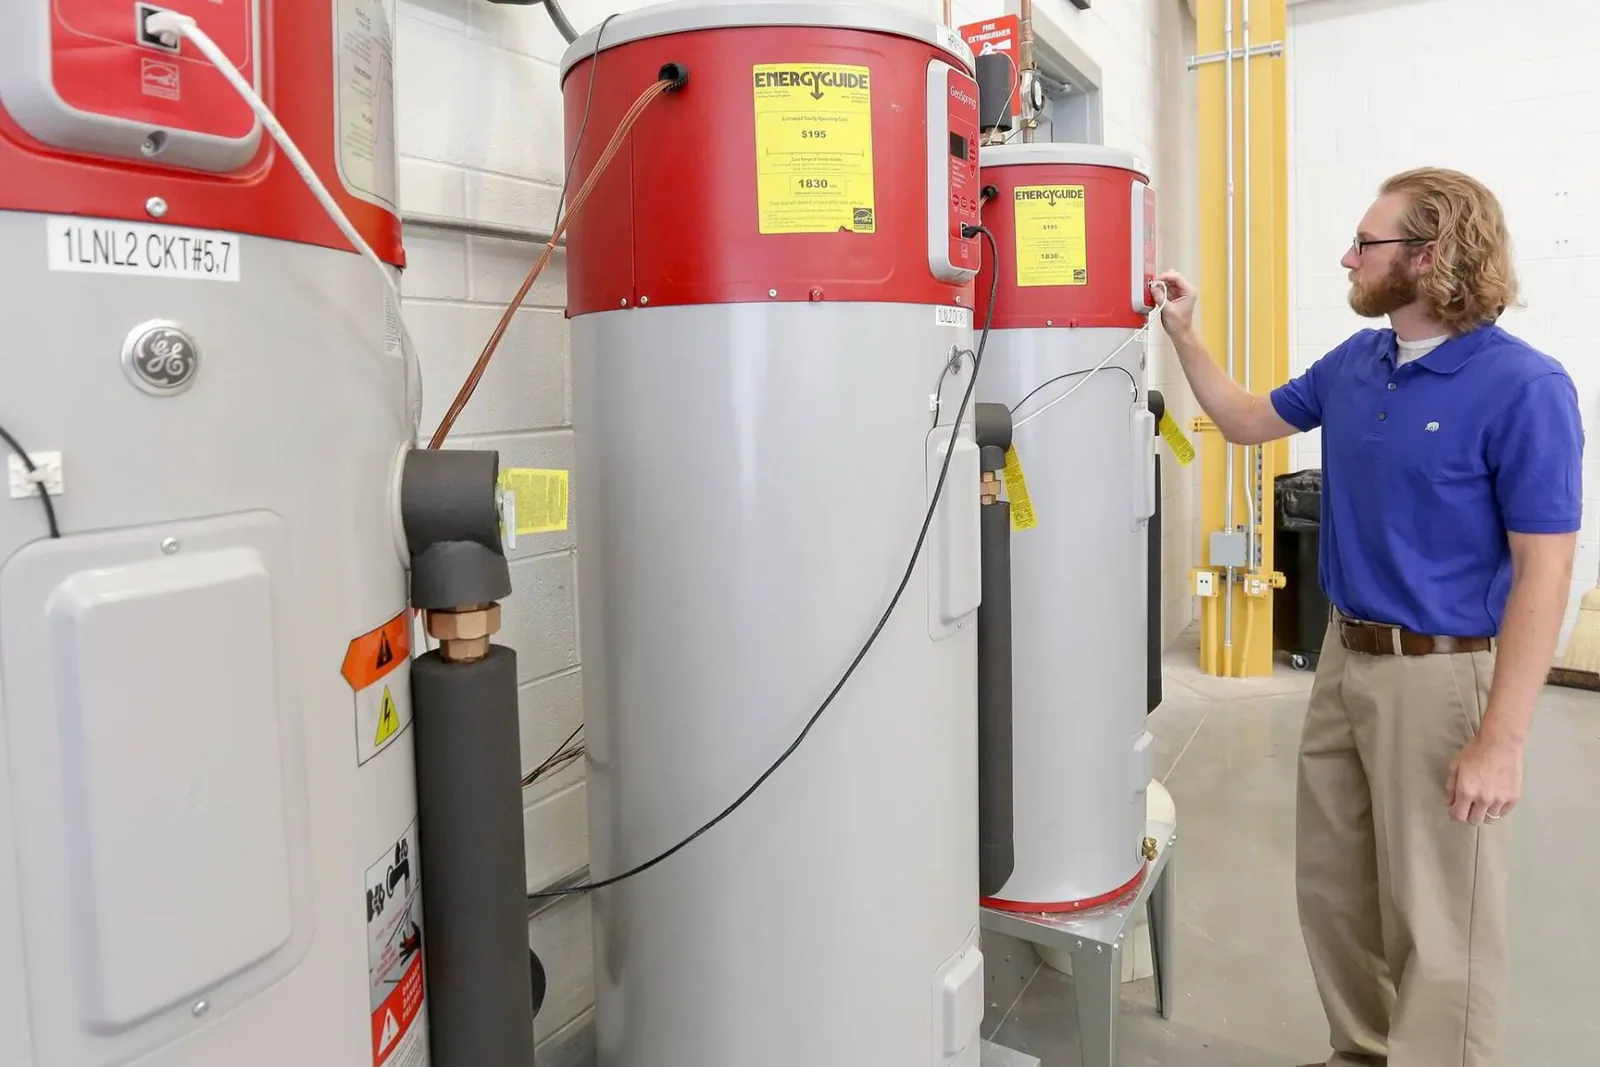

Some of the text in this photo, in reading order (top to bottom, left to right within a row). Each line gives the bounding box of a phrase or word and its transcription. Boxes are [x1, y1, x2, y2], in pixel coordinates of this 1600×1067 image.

[982, 23, 996, 32] FIRE
[968, 28, 1011, 44] EXTINGUISHER
[755, 71, 869, 90] ENERGYGUIDE
[950, 85, 977, 110] GeoSpring
[801, 130, 827, 139] $195
[798, 179, 828, 188] 1830
[1015, 189, 1083, 200] ENERGYGUIDE
[64, 227, 231, 273] 1LNL2 CKT#5,7
